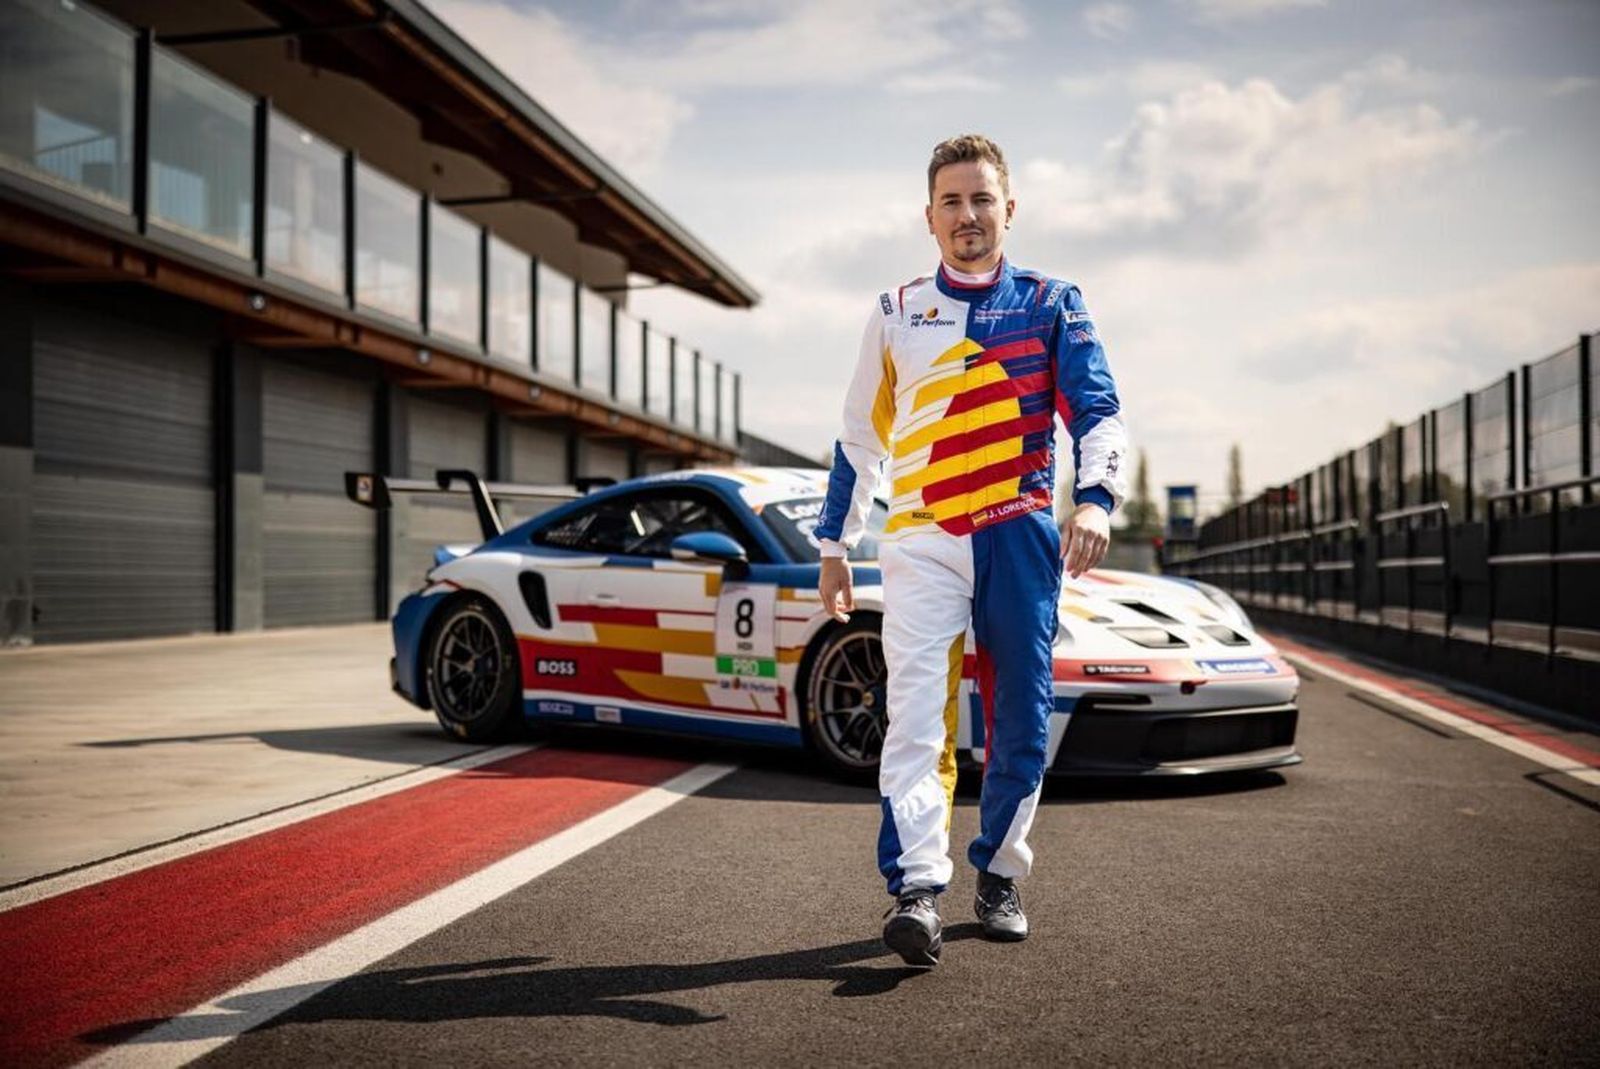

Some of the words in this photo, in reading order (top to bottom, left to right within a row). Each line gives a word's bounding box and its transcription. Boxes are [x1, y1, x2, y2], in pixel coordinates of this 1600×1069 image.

[921, 319, 956, 328] Perform
[735, 598, 754, 639] 8
[538, 660, 576, 675] BOSS
[732, 658, 759, 676] PRO
